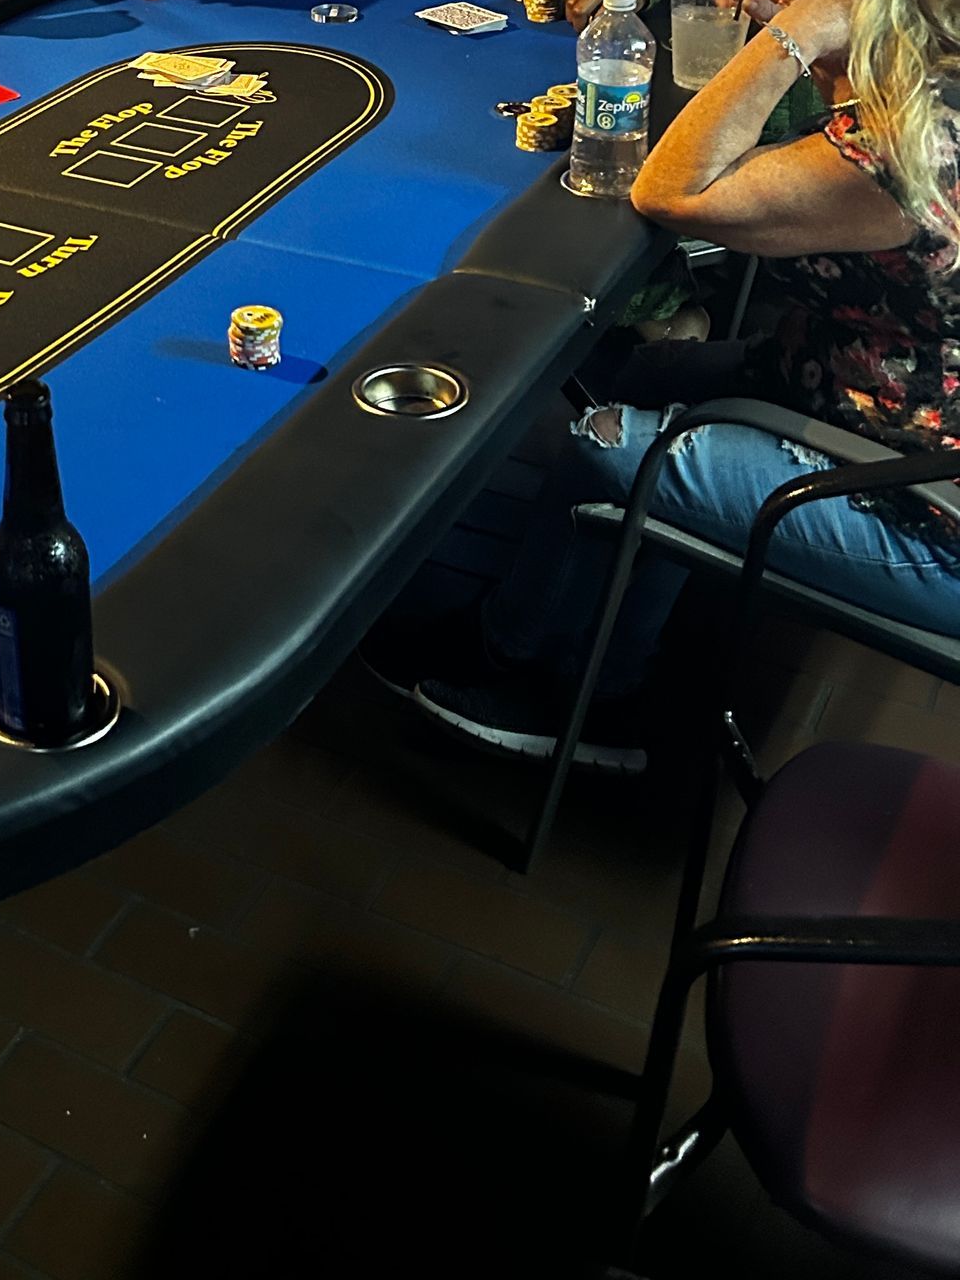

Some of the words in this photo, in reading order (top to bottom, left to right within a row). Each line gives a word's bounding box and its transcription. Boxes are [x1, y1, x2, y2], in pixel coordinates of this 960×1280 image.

[49, 130, 98, 157] The
[88, 102, 153, 130] Flop
[219, 120, 264, 148] The
[164, 148, 232, 179] Flop
[16, 234, 99, 278] Turn
